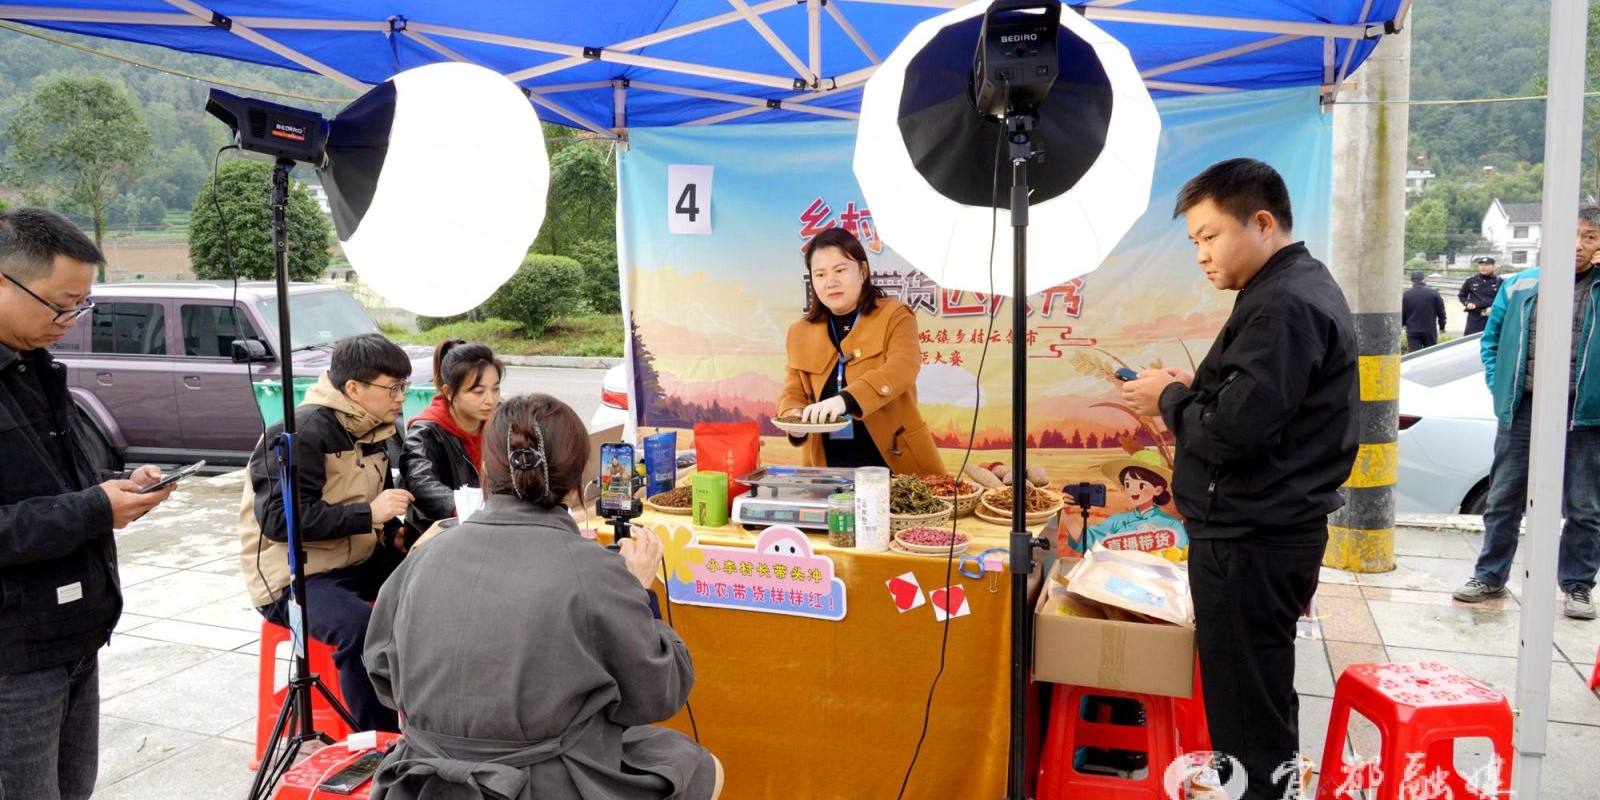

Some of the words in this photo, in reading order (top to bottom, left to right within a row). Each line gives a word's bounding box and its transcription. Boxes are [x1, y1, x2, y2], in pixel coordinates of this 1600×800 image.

[1001, 33, 1038, 43] BEDIRO
[275, 123, 303, 134] BEDIRO
[675, 183, 699, 222] 4
